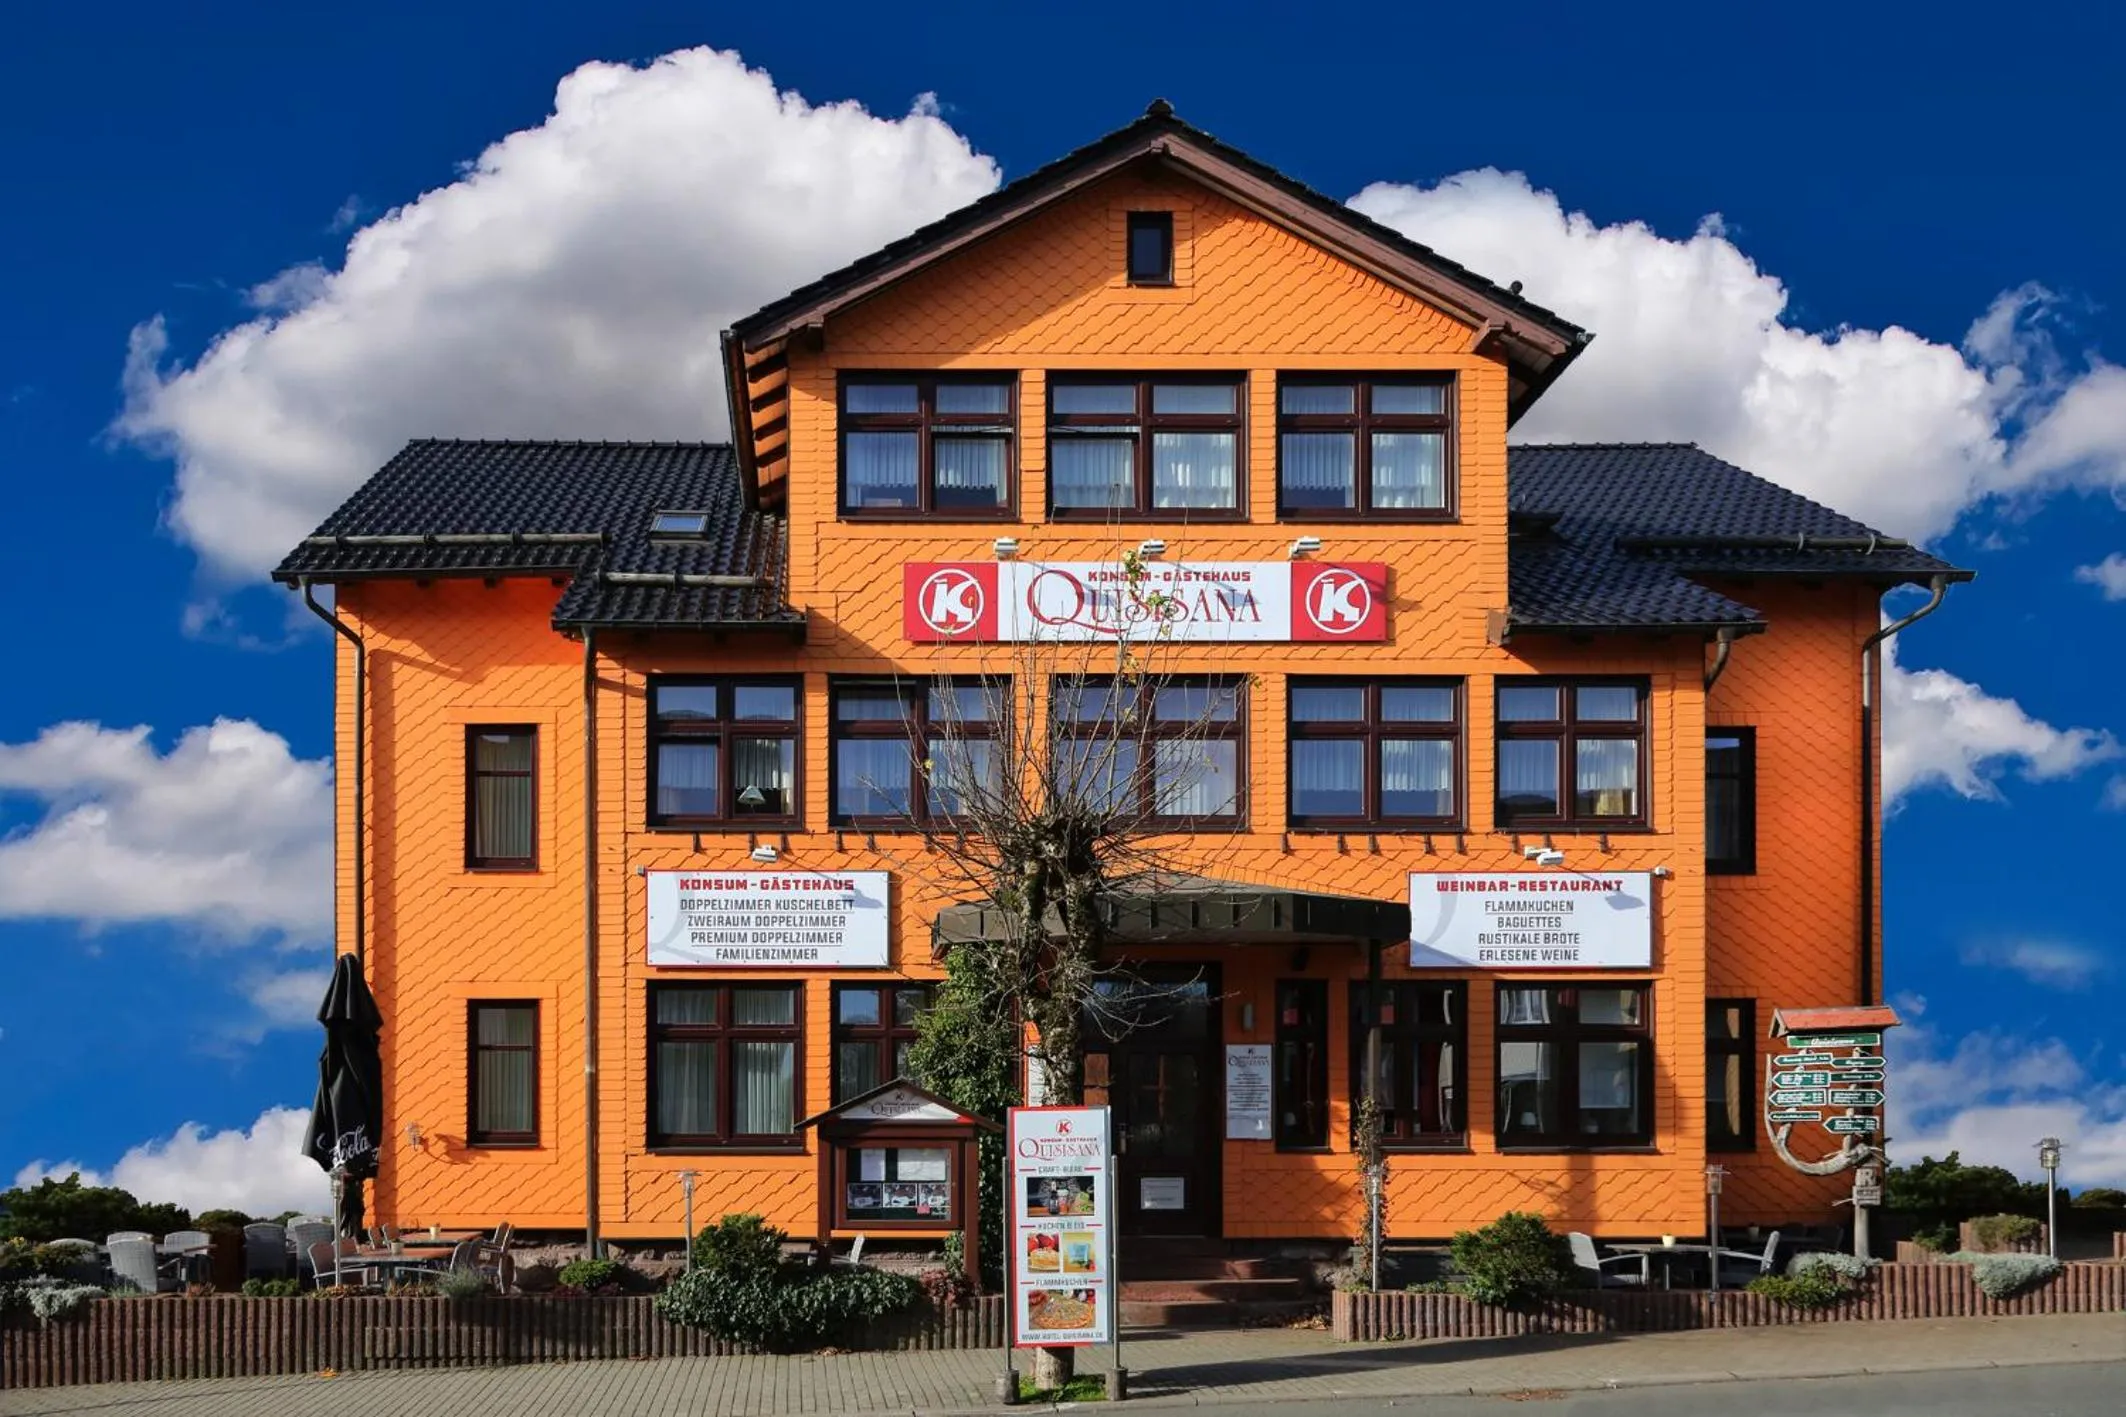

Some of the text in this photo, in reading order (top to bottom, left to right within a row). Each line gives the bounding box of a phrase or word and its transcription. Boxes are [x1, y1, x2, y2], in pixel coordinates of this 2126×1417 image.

[1318, 578, 1366, 623] K
[1436, 880, 1623, 892] WEINBAR-RESTAURANT
[680, 899, 855, 911] DOPPELZIMMER KUSCHELBETT
[1484, 901, 1574, 912] FLAMMKUCHEN
[687, 916, 846, 927] ZWEIRAUM DOPPELZIMMER
[1497, 917, 1562, 928] BAGUETTES
[691, 932, 843, 943] PREMIUM DOPPELZIMMER
[1478, 933, 1580, 944] RUSTIKALE BROTE
[716, 948, 818, 960] FAMILIENZIMMER
[1479, 949, 1579, 961] ERLESENE WEINE
